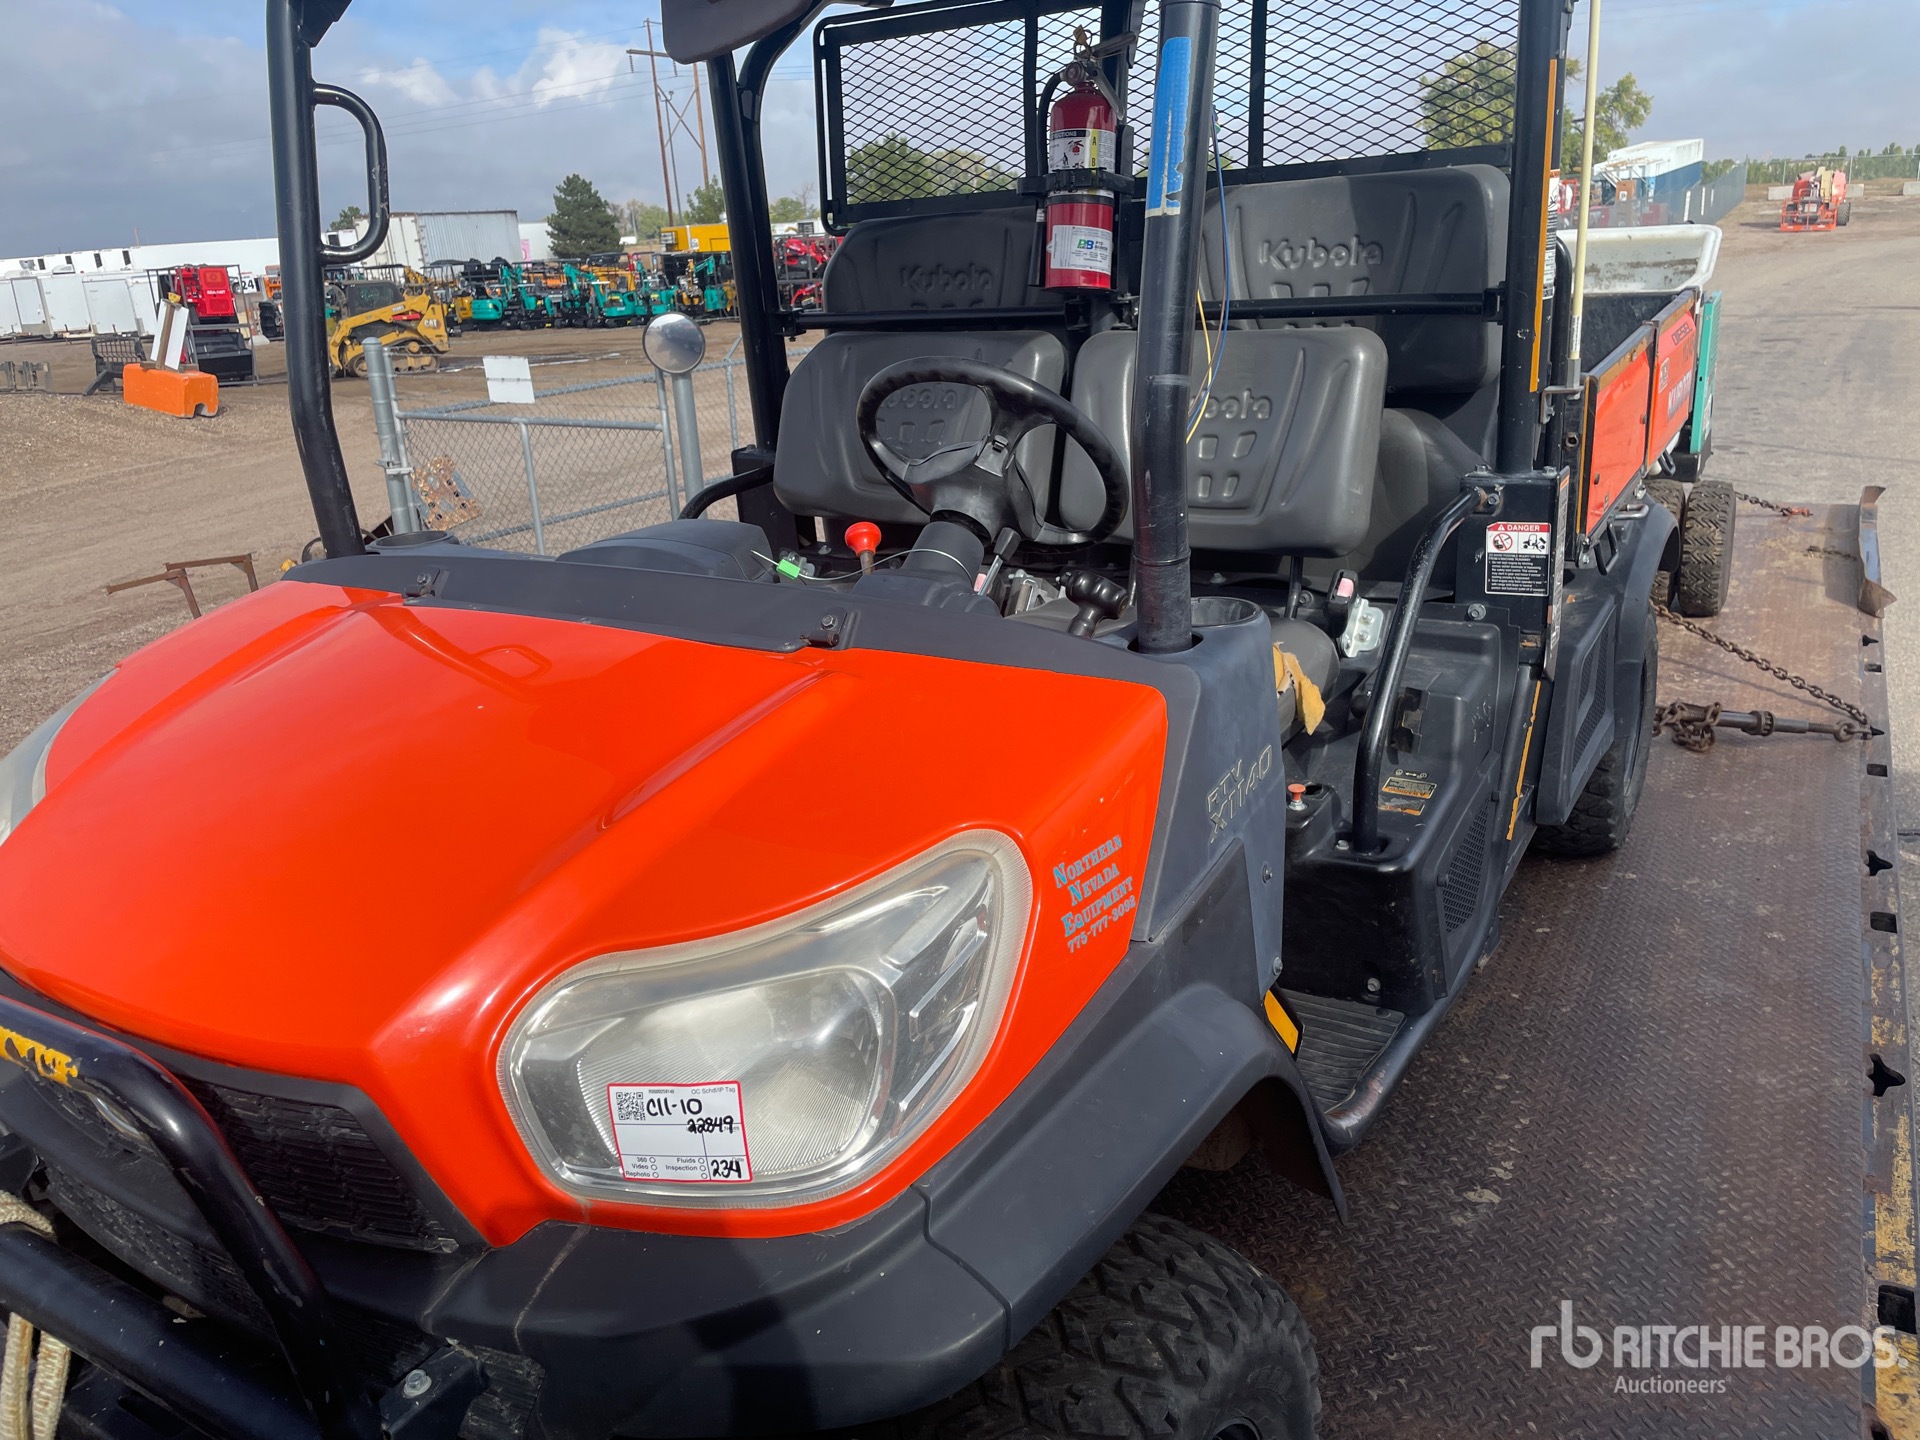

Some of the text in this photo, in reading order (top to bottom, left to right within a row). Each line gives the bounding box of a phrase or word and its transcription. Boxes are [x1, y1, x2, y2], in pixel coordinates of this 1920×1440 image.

[1092, 136, 1097, 146] A
[1091, 157, 1096, 167] B
[1259, 235, 1384, 270] Kubota
[900, 262, 994, 292] Kubota
[423, 319, 438, 328] CAT
[1207, 759, 1242, 812] RTV
[1210, 745, 1273, 843] X1140
[1053, 835, 1123, 888] NORTHERN
[1068, 863, 1120, 907] NEVADA
[1061, 876, 1133, 937] EQUIPMENT
[1067, 895, 1136, 953] 775-777-3092
[687, 1115, 734, 1134] 22849
[625, 1170, 651, 1178] Rephoto
[665, 1164, 698, 1172] Inspection
[710, 1159, 741, 1179] 234
